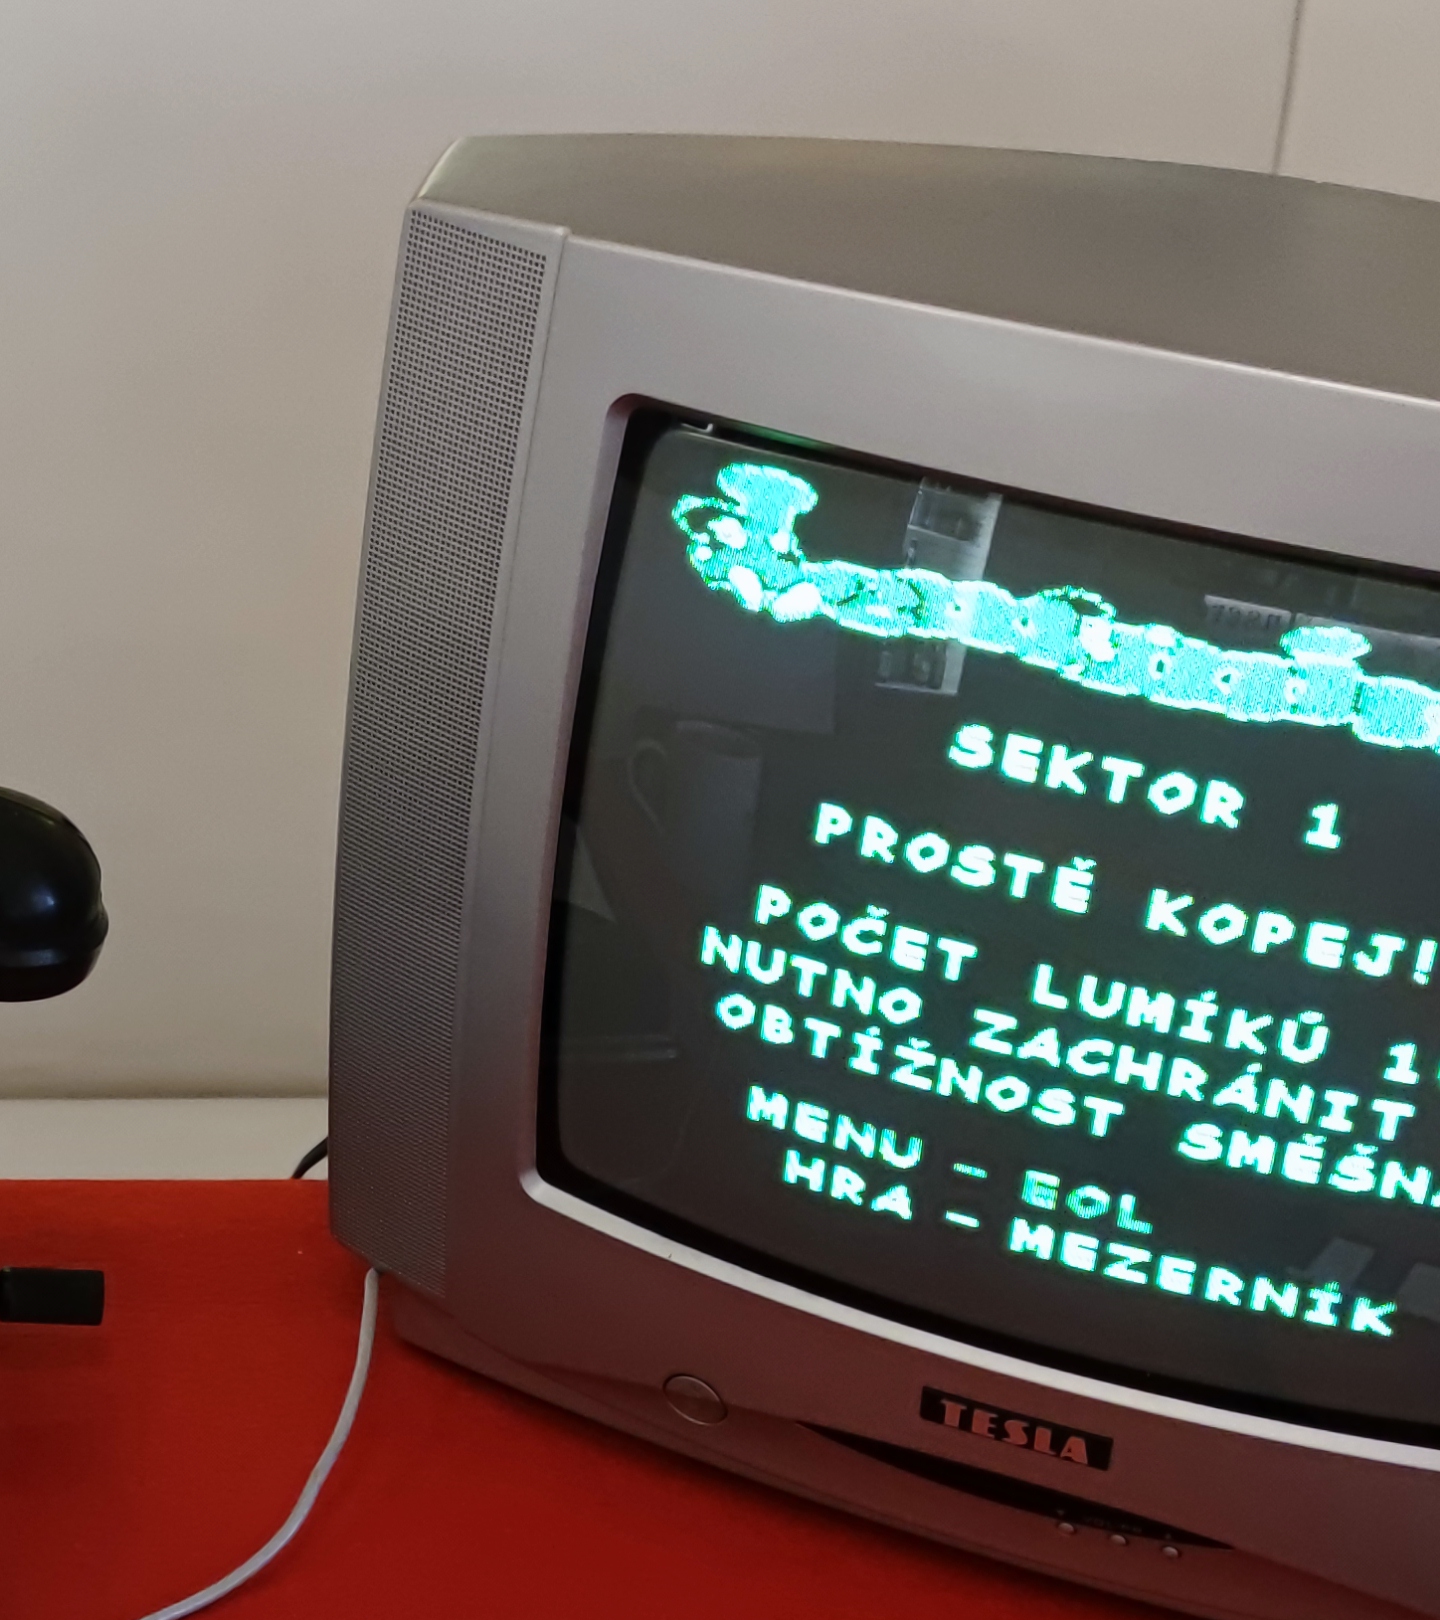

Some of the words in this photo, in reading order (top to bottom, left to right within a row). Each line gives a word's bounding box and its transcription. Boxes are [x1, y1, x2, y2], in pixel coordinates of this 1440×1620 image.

[949, 725, 1243, 828] SEKTOR
[1306, 804, 1340, 848] 1
[754, 885, 978, 982] POČET
[1031, 963, 1333, 1064] LUMÍKŮ
[810, 803, 1096, 917] PROSTĚ
[1146, 889, 1436, 984] KOPEJ!
[700, 927, 922, 1026] NUTNO
[970, 1010, 1416, 1141] ZACHRÁNIT
[716, 994, 1124, 1138] OBTÍŽNOST
[747, 1085, 923, 1169] MENU
[1023, 1171, 1154, 1234] EOL
[784, 1150, 914, 1220] HRA
[1009, 1216, 1398, 1337] MEZERNÍK
[941, 1399, 1088, 1464] TESLA
